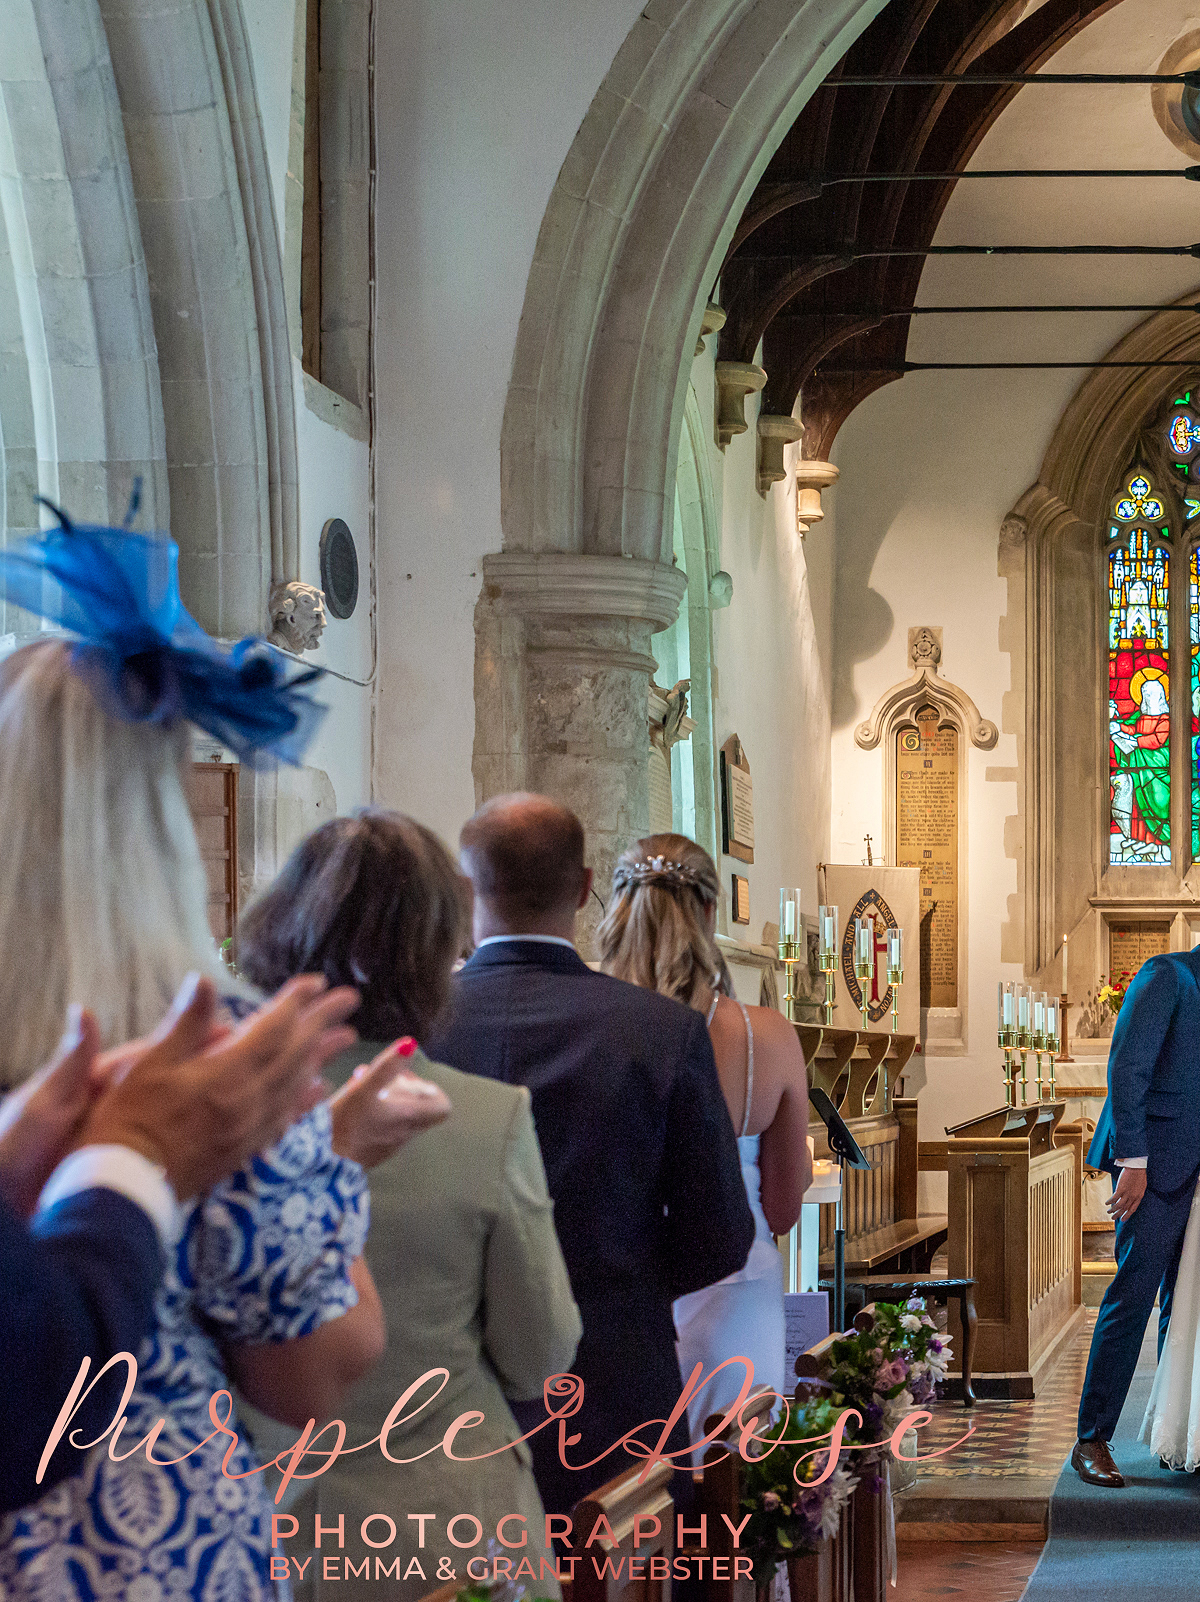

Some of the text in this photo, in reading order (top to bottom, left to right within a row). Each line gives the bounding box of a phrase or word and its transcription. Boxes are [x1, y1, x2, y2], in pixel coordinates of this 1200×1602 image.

[853, 899, 869, 918] ALL
[845, 924, 856, 945] AND
[844, 953, 860, 997] MICHAEL
